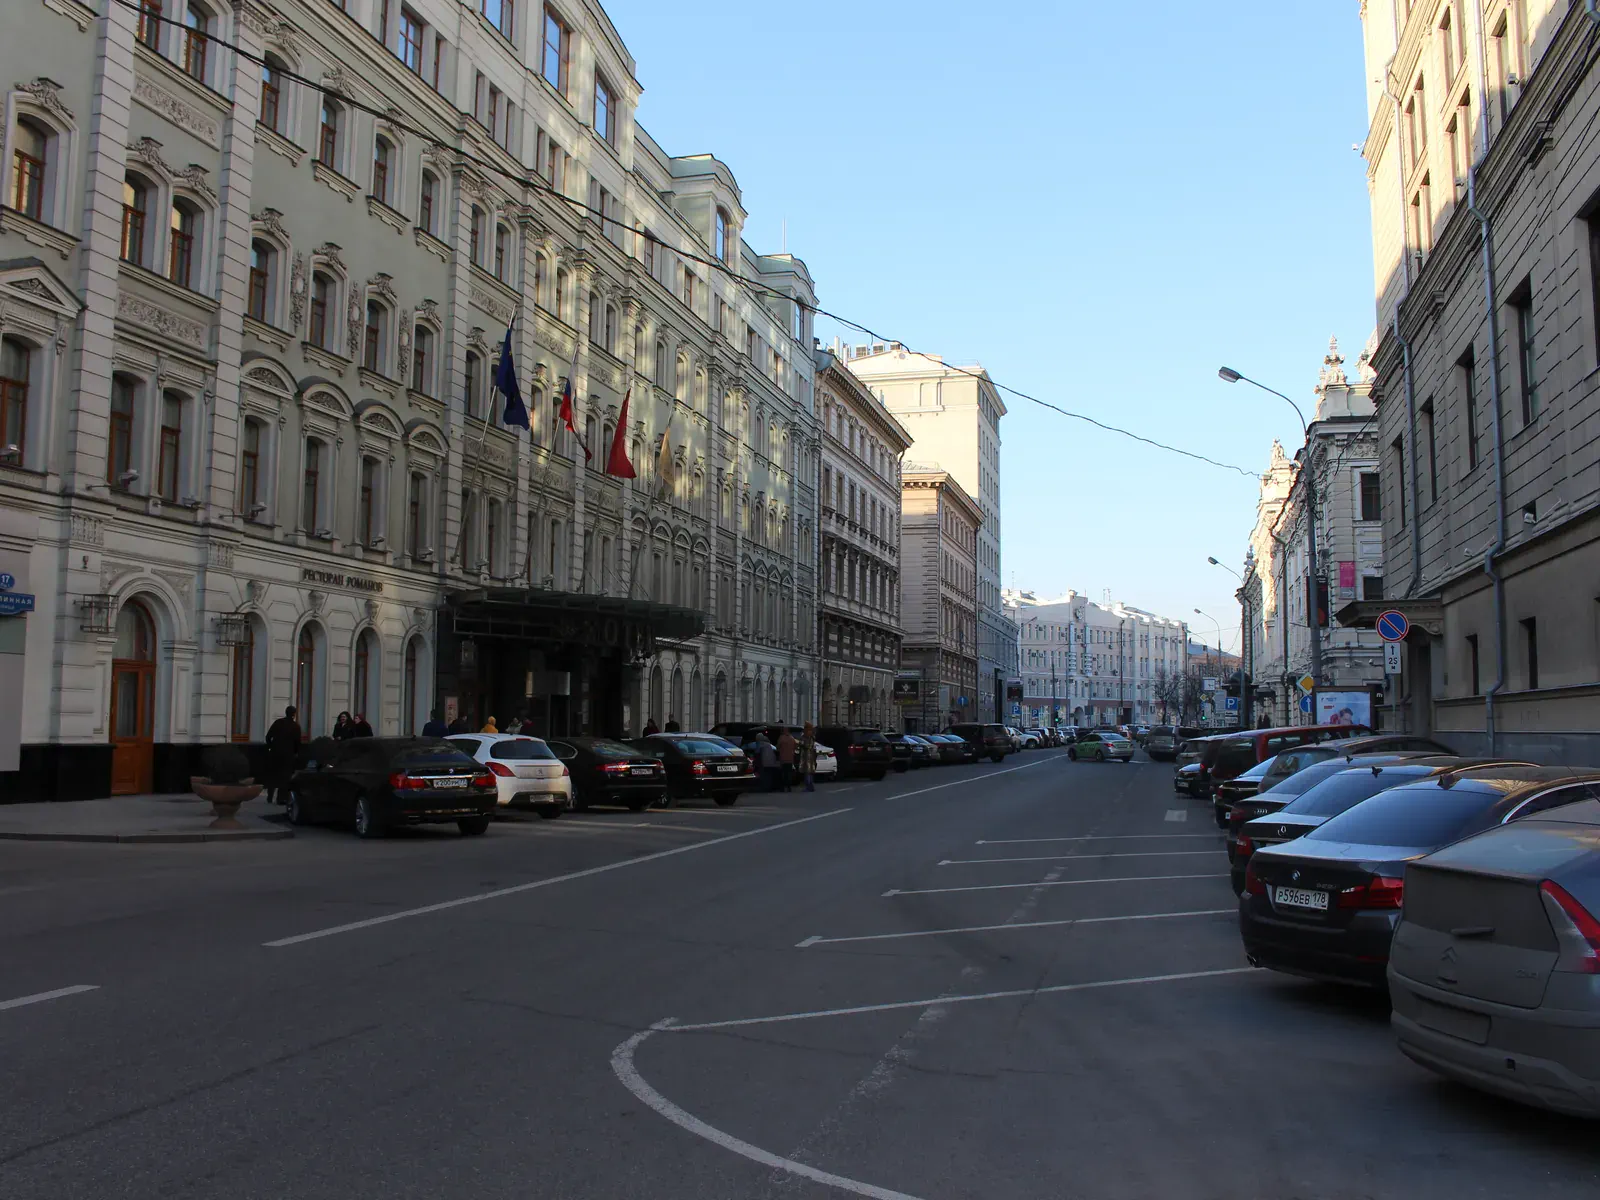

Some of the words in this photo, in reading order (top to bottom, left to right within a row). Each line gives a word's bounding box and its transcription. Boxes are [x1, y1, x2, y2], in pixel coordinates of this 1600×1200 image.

[1, 575, 10, 583] 17
[303, 568, 344, 585] РЕСТОРАН
[346, 576, 383, 592] РОМАНОВ
[1388, 657, 1398, 665] 25
[1312, 892, 1326, 904] 178
